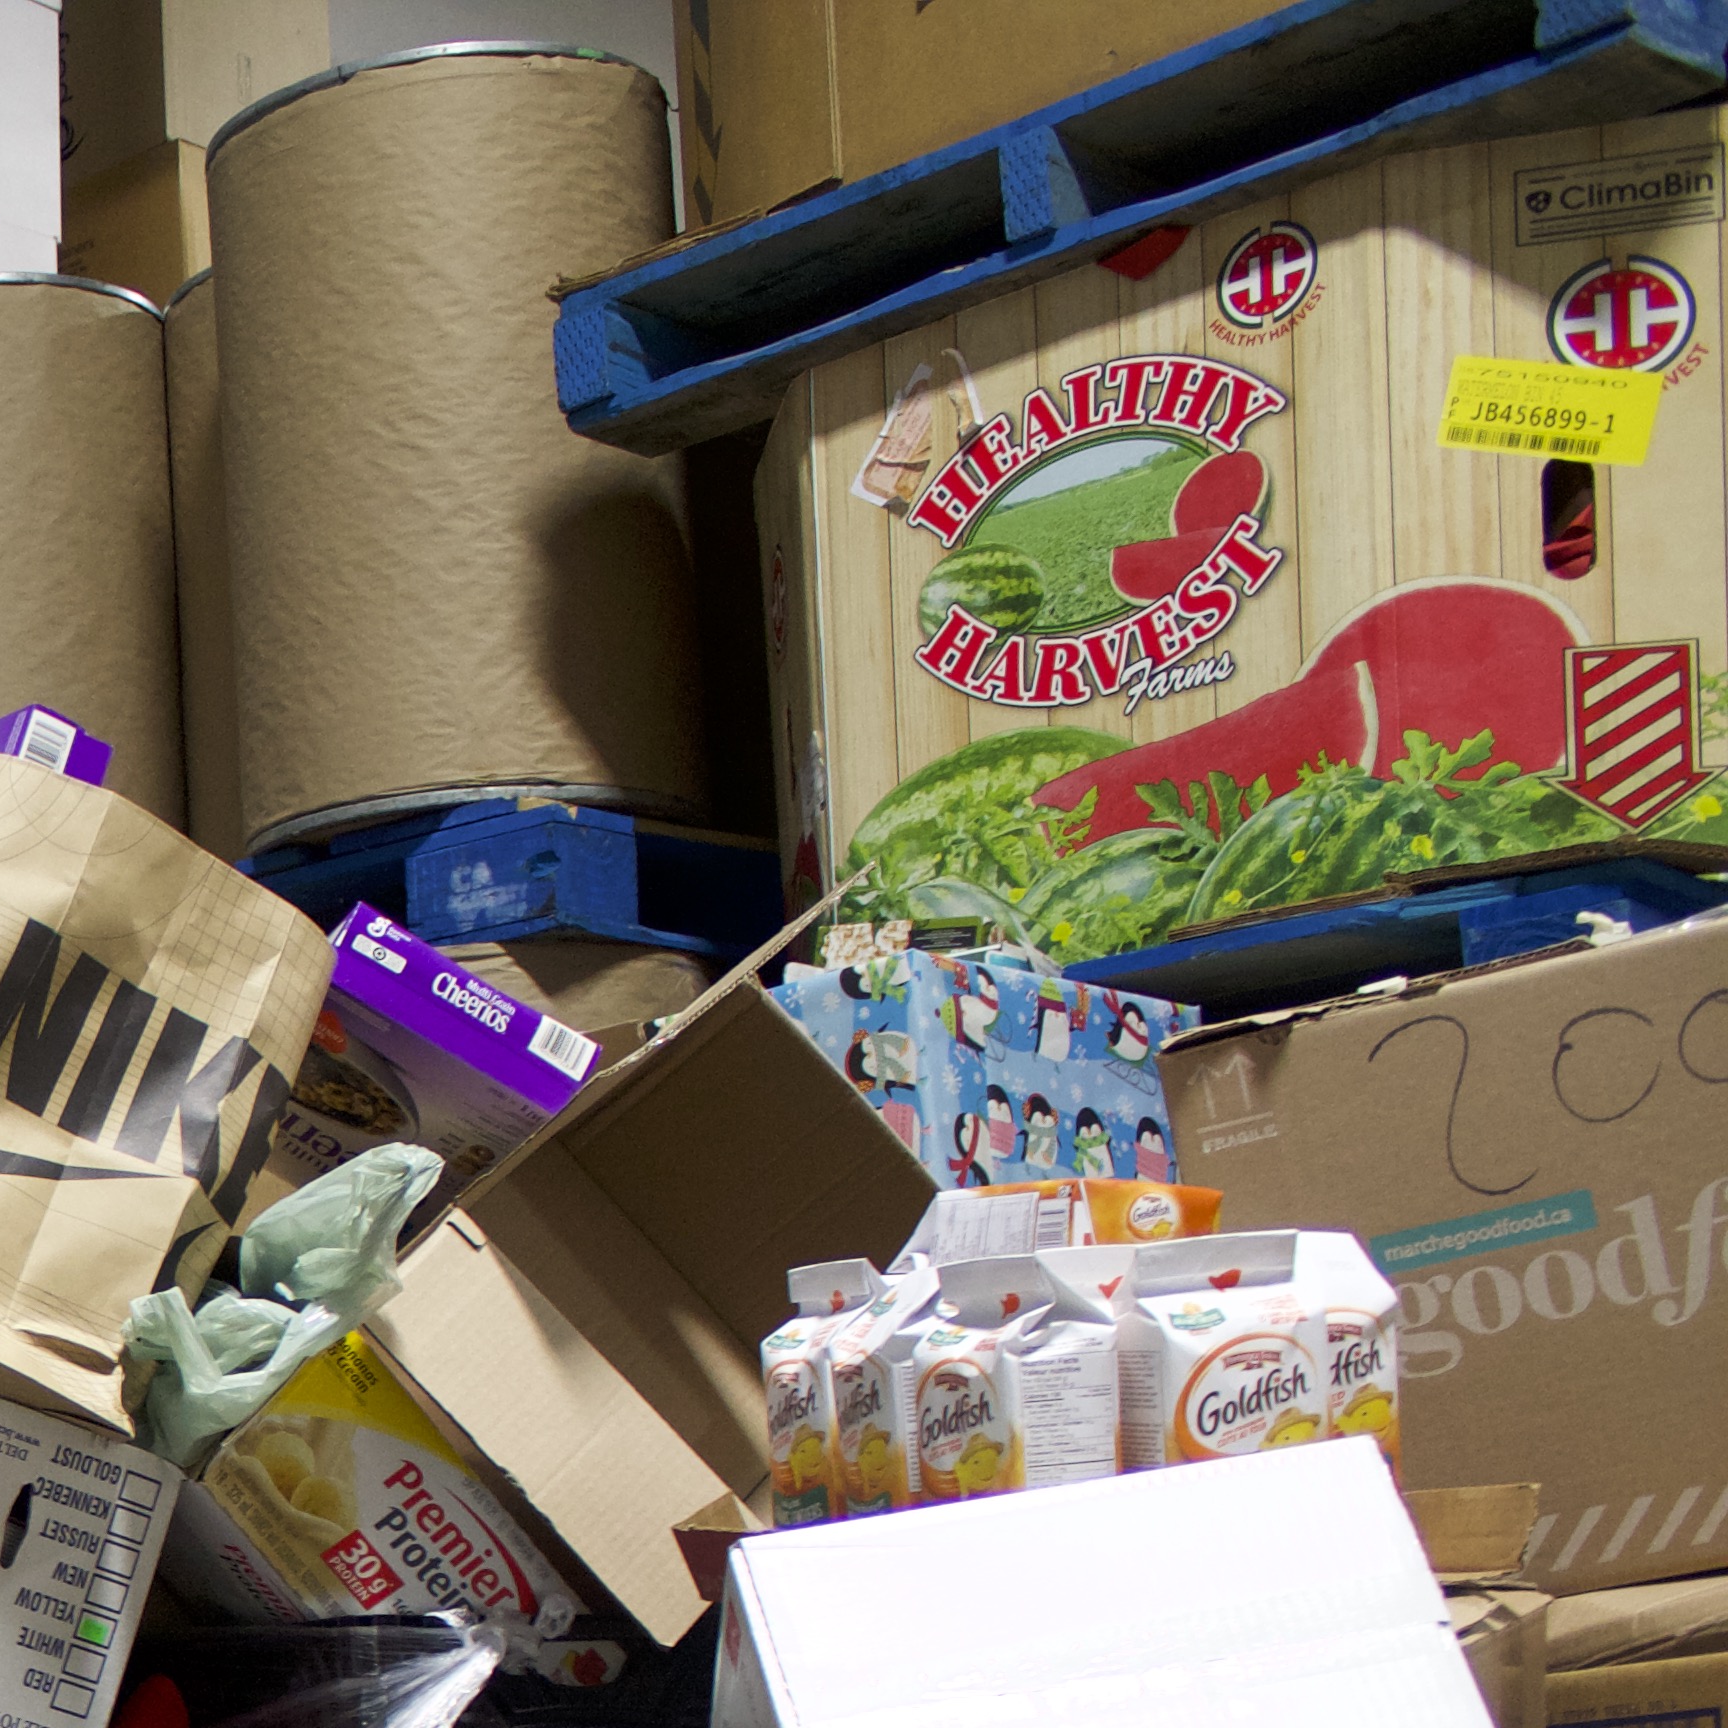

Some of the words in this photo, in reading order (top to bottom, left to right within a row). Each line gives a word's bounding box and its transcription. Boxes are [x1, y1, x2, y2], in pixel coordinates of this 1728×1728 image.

[1560, 168, 1715, 210] ClimaBin
[1207, 318, 1267, 348] HEALTHY
[1470, 400, 1617, 435] JB456899-1
[908, 354, 1286, 548] HEALTHY
[915, 513, 1286, 708] HARVEST
[1122, 650, 1234, 715] Farms
[431, 972, 511, 1034] Cheerios
[1383, 1207, 1574, 1263] marchegoodfood.ca
[920, 1392, 995, 1448] Goldfish
[1196, 1363, 1311, 1438] Goldfish
[51, 1443, 122, 1485] GOLDUST
[34, 1477, 112, 1519] KENNEBEC
[40, 1518, 101, 1553] RUSSET
[383, 1459, 515, 1608] Premier
[52, 1561, 89, 1588] NEW
[329, 1556, 371, 1603] PROTEIN
[374, 1506, 474, 1613] Protein
[14, 1587, 76, 1625] YELLOW
[16, 1626, 66, 1660] WHITE
[23, 1668, 55, 1693] RED
